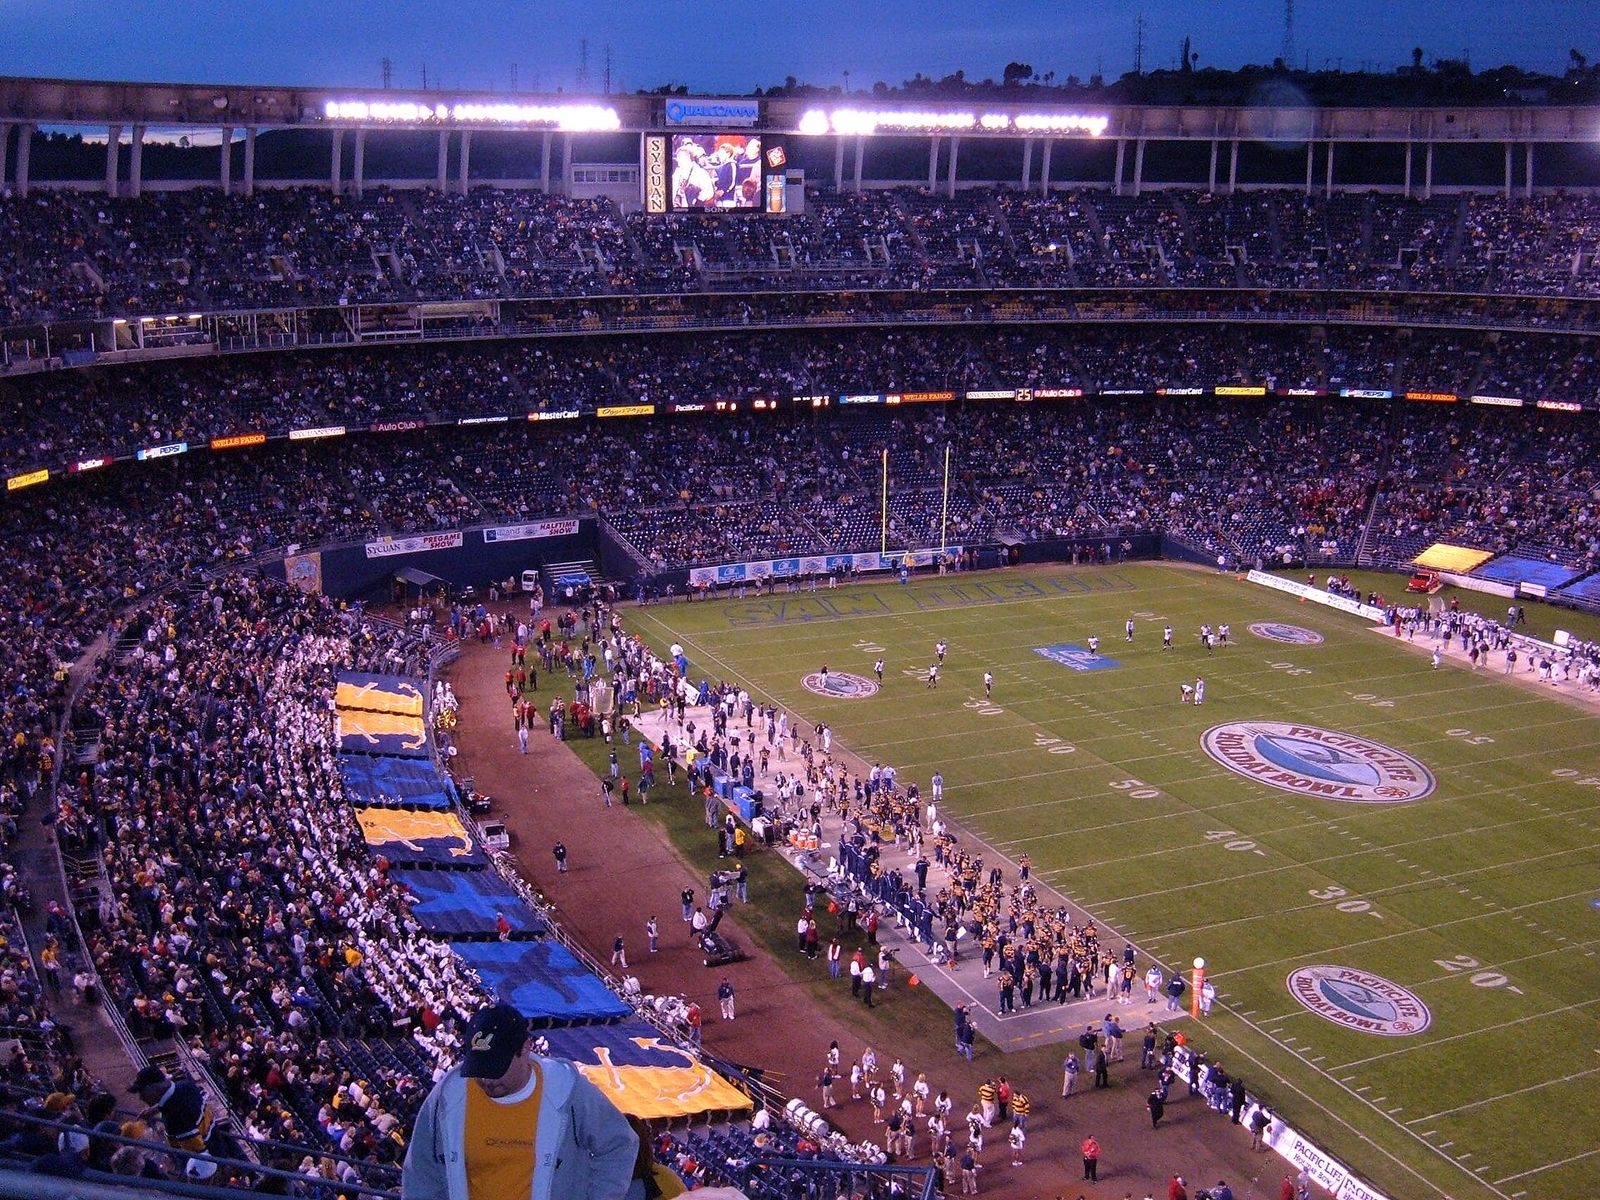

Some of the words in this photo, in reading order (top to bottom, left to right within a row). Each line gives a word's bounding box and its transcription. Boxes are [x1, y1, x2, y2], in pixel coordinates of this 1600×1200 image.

[650, 139, 663, 210] SYCUAN
[904, 393, 928, 401] WELLS
[929, 392, 952, 400] FARGO
[1017, 389, 1031, 401] 25
[1058, 389, 1075, 397] Club
[1560, 403, 1575, 411] Club
[539, 410, 579, 421] MasterCard
[377, 423, 396, 432] Auto
[398, 421, 417, 430] Club
[213, 438, 239, 448] WELLS
[240, 435, 265, 444] FARGO
[541, 520, 576, 531] HALFTIME
[549, 527, 573, 536] SHOW
[423, 533, 461, 544] PREGAME
[430, 540, 454, 549] SHOW
[367, 543, 400, 555] SYCUAN
[962, 699, 1004, 715] 30
[1287, 727, 1387, 762] PACIFIC
[1445, 728, 1495, 745] 50
[1034, 738, 1076, 754] 40
[1215, 731, 1274, 780] HOLIDAY
[1266, 772, 1364, 798] BOWL
[1109, 779, 1160, 799] 50
[1205, 830, 1257, 851] 40
[1308, 885, 1372, 913] 30
[1432, 954, 1509, 988] 20
[1338, 970, 1403, 999] PACIFIC
[1296, 976, 1338, 1014] HOLIDAY
[1330, 1011, 1388, 1032] BOWL
[1294, 1140, 1325, 1169] PACIFIC
[1324, 1162, 1343, 1182] LIFE
